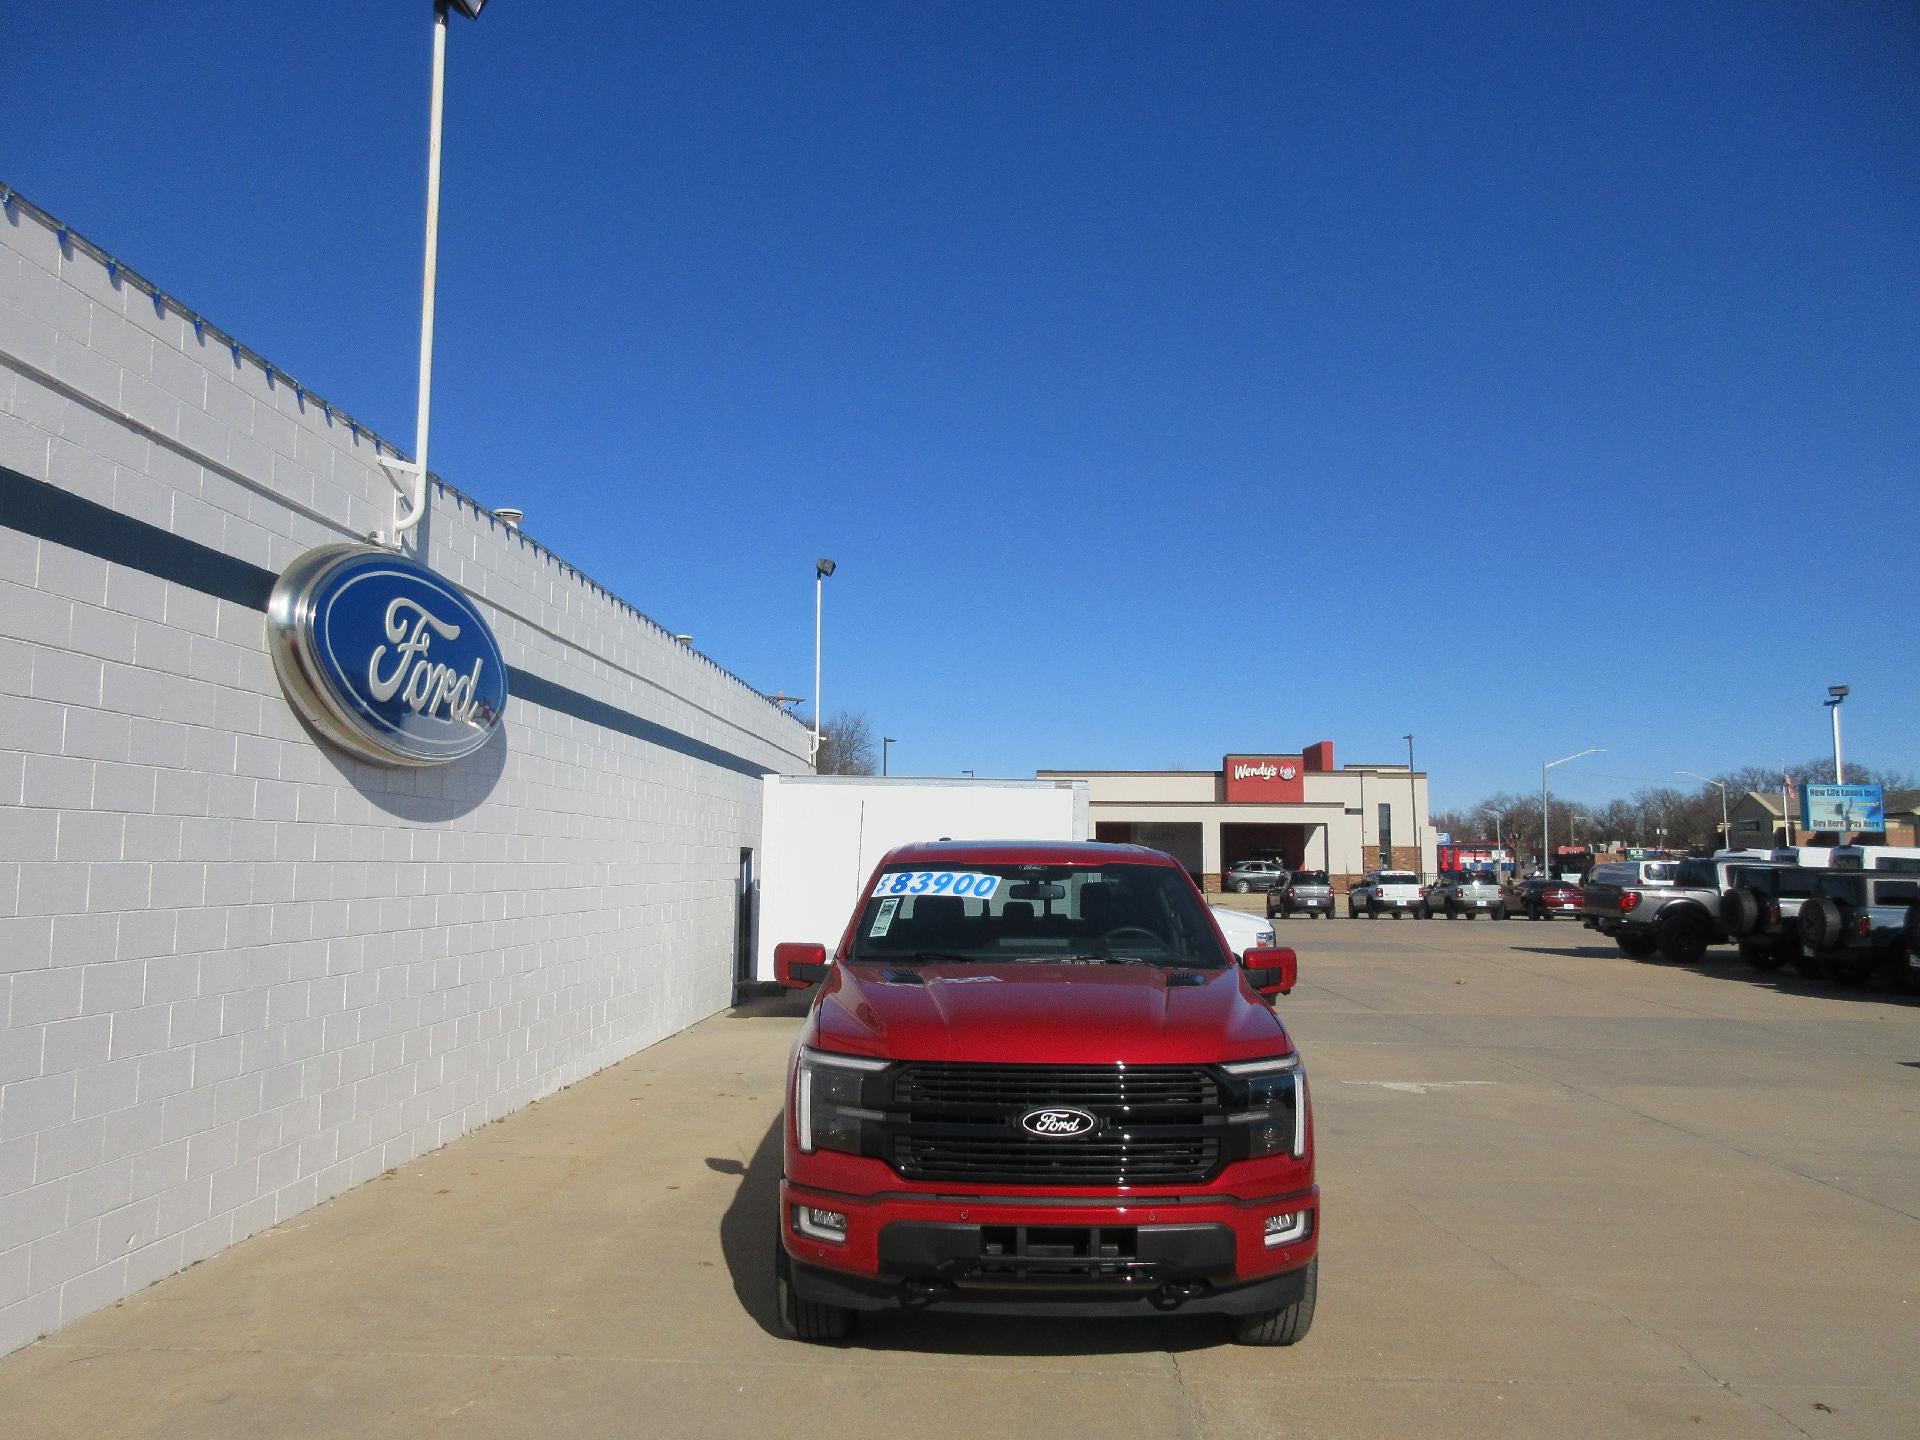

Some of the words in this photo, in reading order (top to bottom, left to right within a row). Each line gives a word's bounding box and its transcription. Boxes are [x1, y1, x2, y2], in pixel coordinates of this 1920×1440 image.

[368, 597, 483, 726] Ford
[1234, 762, 1278, 780] Wendy's
[1810, 788, 1826, 797] New
[1826, 788, 1841, 797] Life
[1812, 820, 1827, 828] Buy
[1827, 820, 1844, 828] Here
[1863, 820, 1880, 828] Here
[1036, 1112, 1080, 1132] Ford
